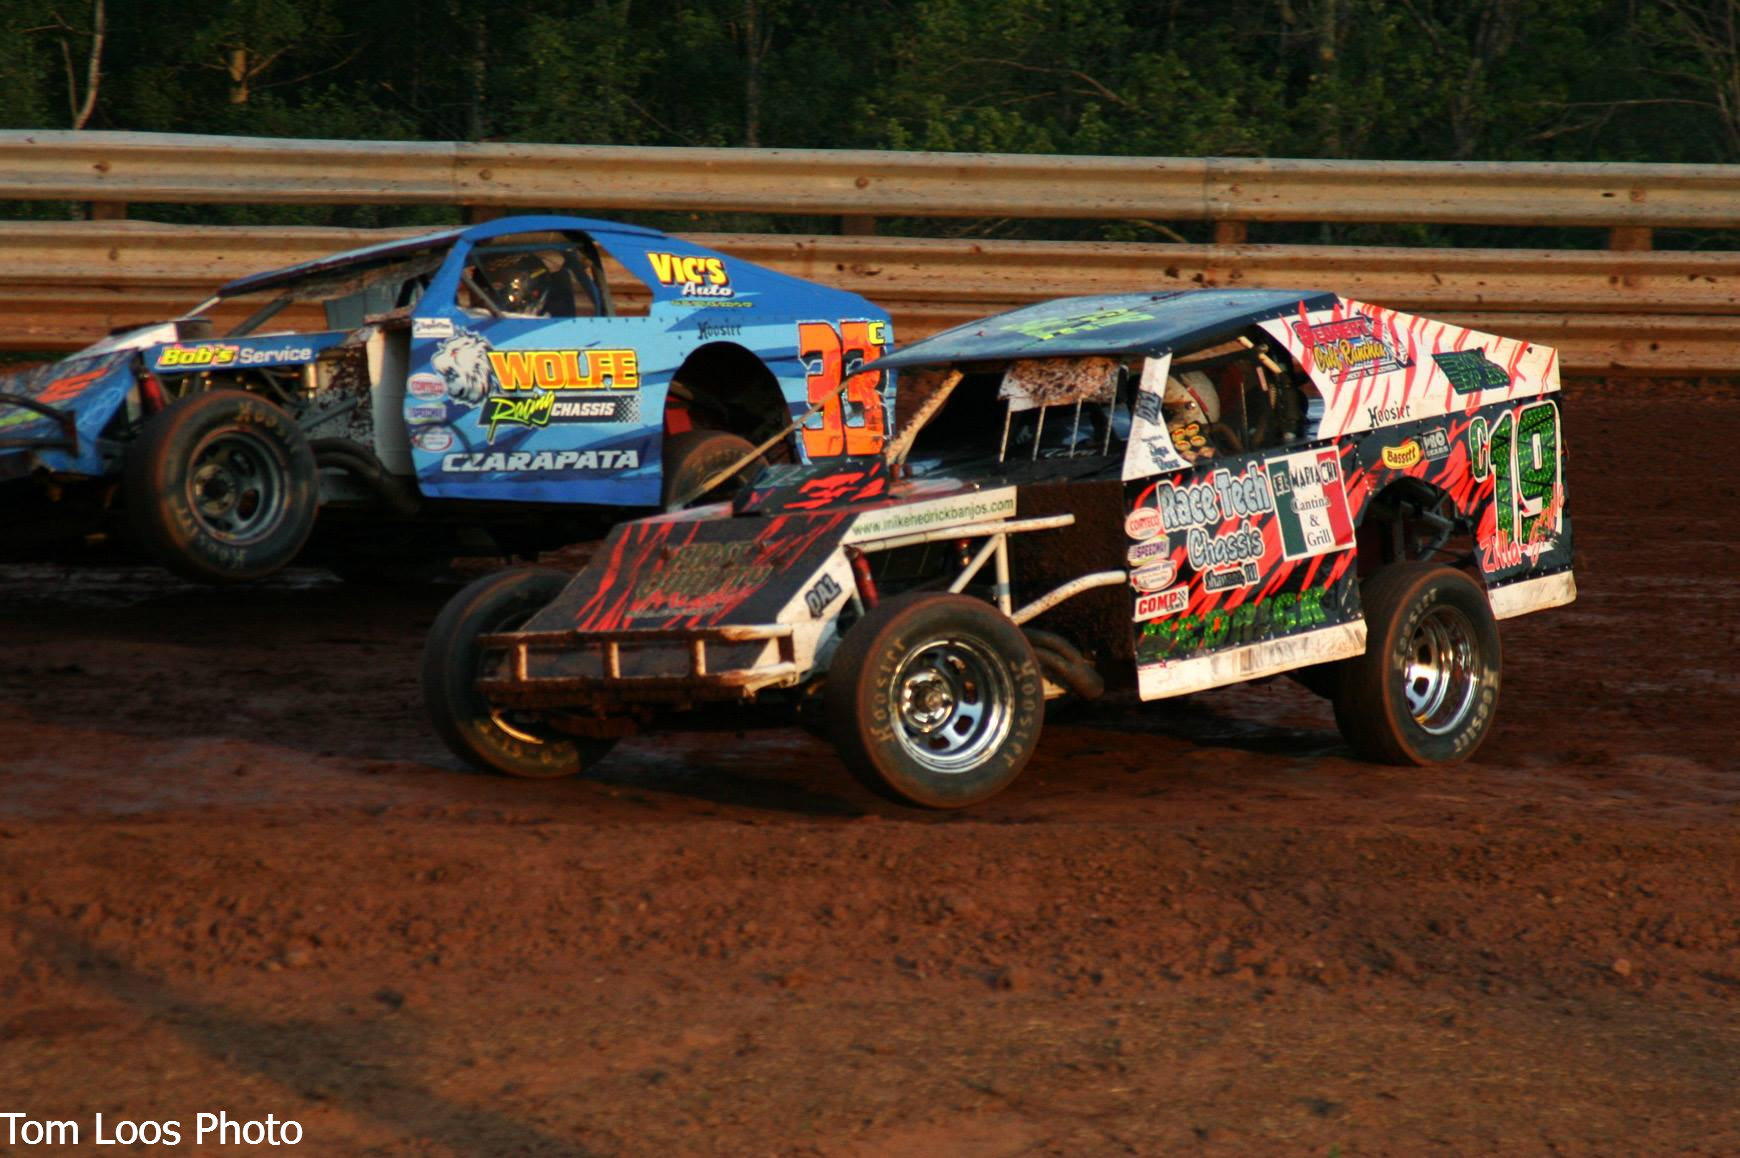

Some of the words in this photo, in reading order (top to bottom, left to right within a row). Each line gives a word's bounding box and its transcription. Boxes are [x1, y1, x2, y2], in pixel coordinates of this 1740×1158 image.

[648, 252, 727, 285] VIC'S
[682, 281, 734, 297] Auto
[697, 322, 741, 339] Hoosier
[159, 344, 238, 367] Bob's
[240, 346, 312, 364] Service
[487, 349, 640, 391] WOLFE
[486, 391, 556, 445] Racing
[551, 402, 616, 417] CHASSIS
[1368, 401, 1411, 428] Hoosier
[1423, 431, 1445, 449] PRO
[441, 451, 640, 472] CZARAPATA
[1387, 447, 1416, 465] Bassett
[1273, 475, 1289, 496] EL
[1289, 460, 1338, 487] MARIACHI
[1158, 483, 1217, 530] Race
[1214, 463, 1272, 519] Tech
[1293, 494, 1330, 514] Cantina
[852, 499, 1013, 536] www.mikehedrickbanjos.com
[1310, 514, 1320, 527] &
[1189, 522, 1263, 569] Chassis
[1306, 533, 1332, 548] Grill
[1138, 592, 1177, 615] COMP
